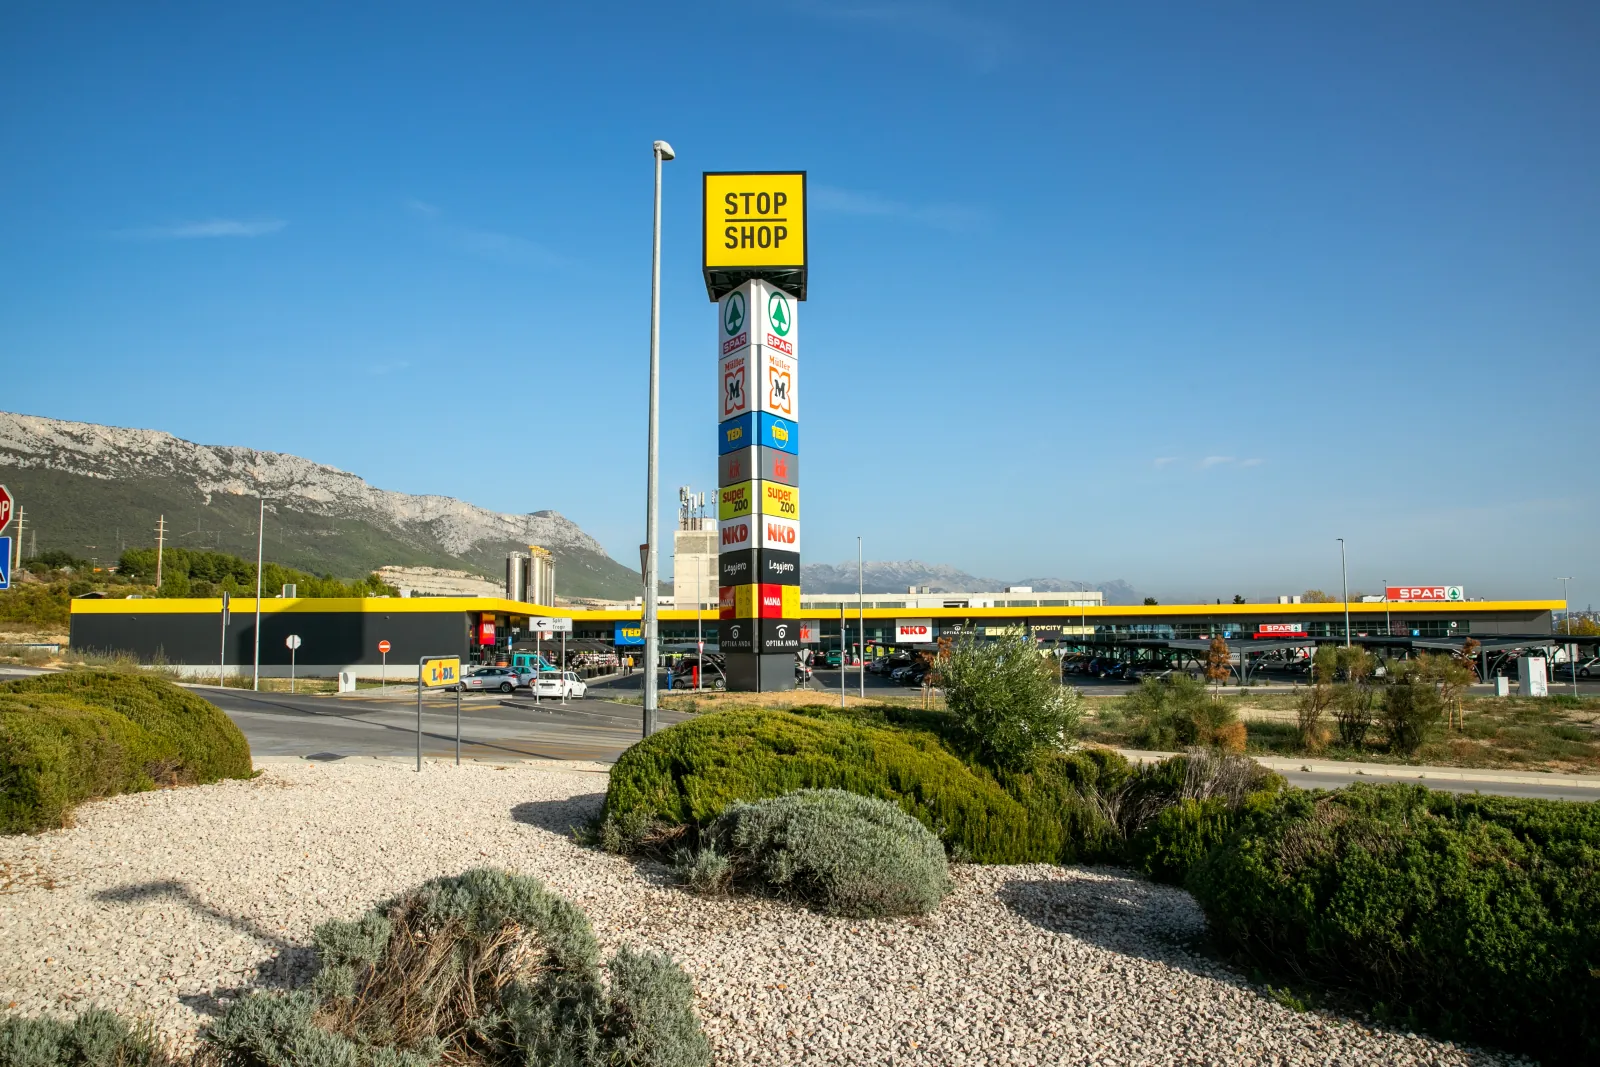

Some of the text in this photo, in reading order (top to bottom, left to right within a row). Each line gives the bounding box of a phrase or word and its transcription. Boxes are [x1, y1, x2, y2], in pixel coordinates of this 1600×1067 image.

[725, 191, 787, 215] STOP
[725, 225, 788, 249] SHOP
[723, 336, 746, 353] SPAR
[768, 336, 792, 353] SPAR
[724, 357, 745, 372] Müller
[769, 355, 791, 371] Müller
[729, 379, 740, 400] M
[775, 379, 786, 400] M
[722, 487, 745, 504] super
[767, 487, 792, 502] super
[722, 523, 748, 545] NKD
[767, 523, 795, 544] NKD
[724, 562, 747, 575] Leggiero
[769, 559, 794, 574] Leggiero
[1399, 588, 1445, 598] SPAR
[621, 628, 641, 637] TED
[900, 626, 928, 635] NKD
